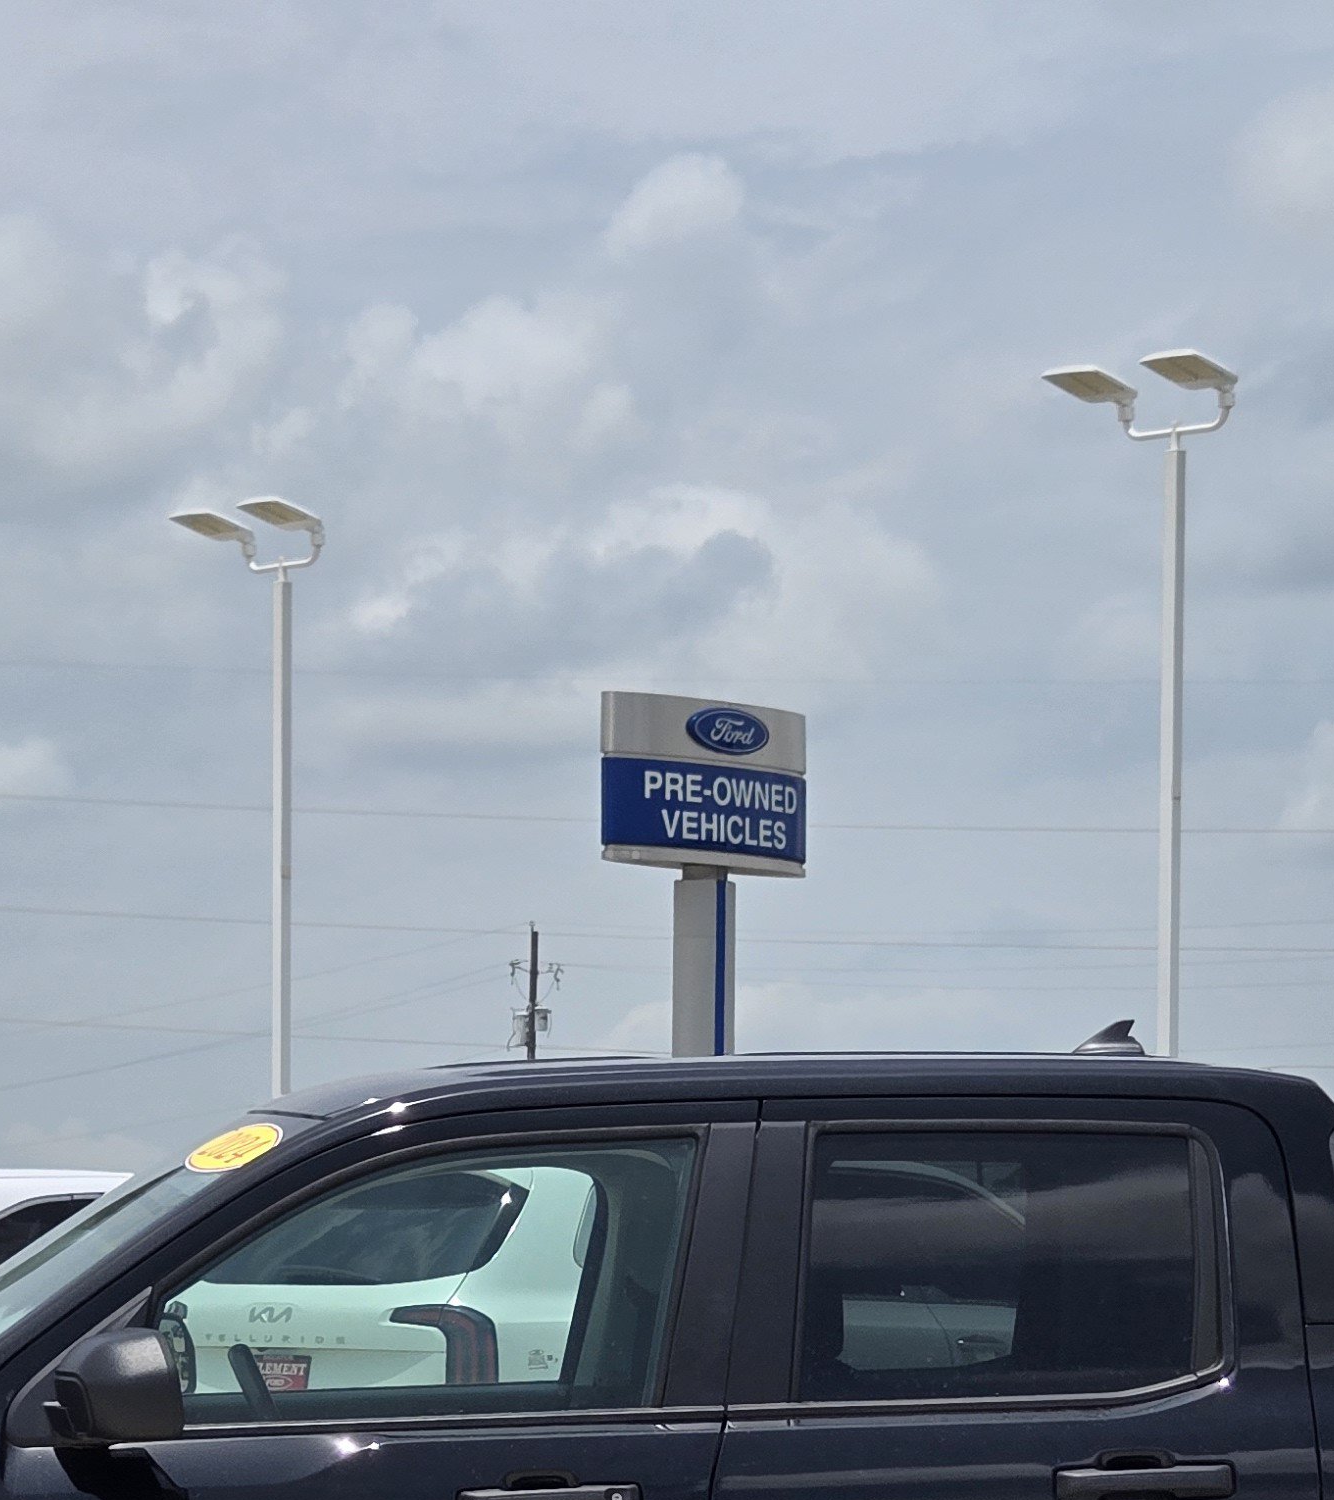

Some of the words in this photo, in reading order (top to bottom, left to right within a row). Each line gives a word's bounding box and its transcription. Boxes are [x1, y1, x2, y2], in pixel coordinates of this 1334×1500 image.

[710, 718, 755, 745] Ford
[644, 771, 797, 814] PRE-OWNED
[661, 809, 787, 850] VEHICLES
[205, 1333, 346, 1345] TELLURIDE
[257, 1362, 308, 1376] LEMENT
